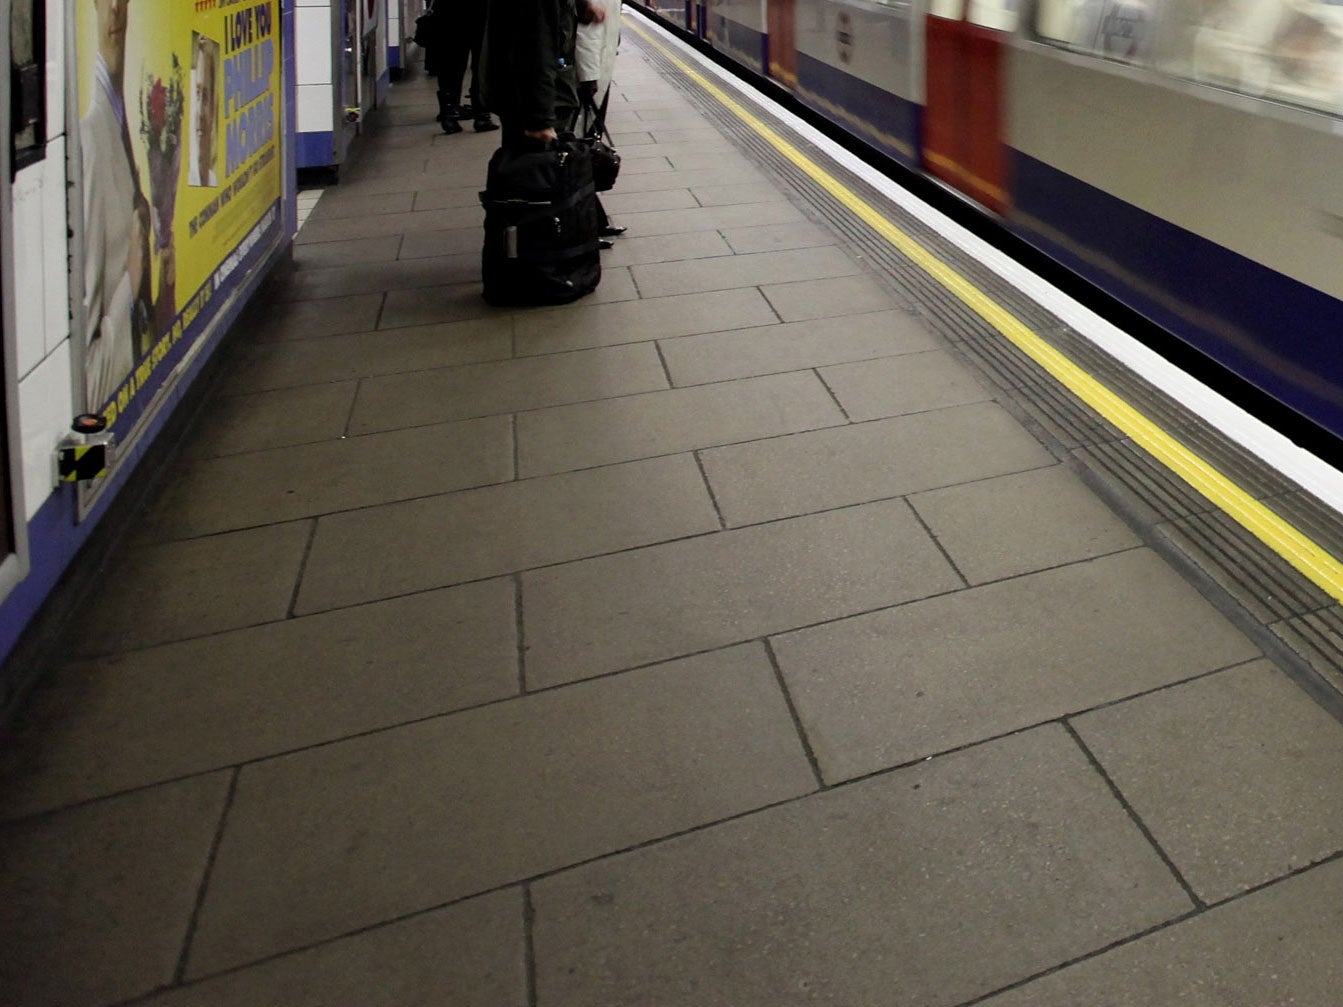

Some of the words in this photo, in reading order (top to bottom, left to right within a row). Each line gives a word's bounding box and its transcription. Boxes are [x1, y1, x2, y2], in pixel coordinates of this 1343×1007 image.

[223, 16, 229, 55] I
[230, 8, 254, 52] LOVE
[254, 1, 273, 40] YOU
[223, 38, 275, 120] PHILLIP
[224, 92, 276, 179] MORRIS
